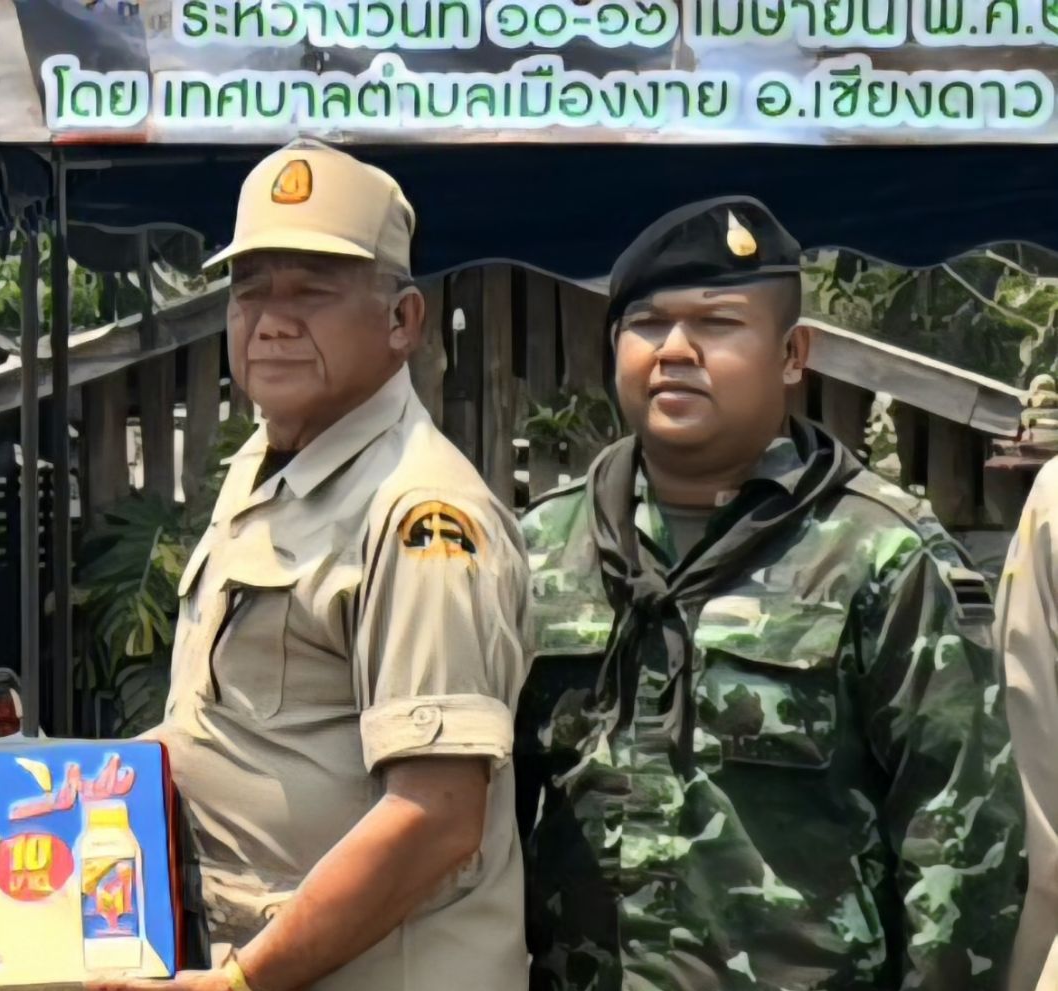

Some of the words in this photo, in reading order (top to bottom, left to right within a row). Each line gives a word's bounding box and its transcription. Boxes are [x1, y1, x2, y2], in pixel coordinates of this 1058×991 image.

[53, 65, 137, 118] โดย
[164, 62, 728, 118] เทศบาลตำบลเมืองงาย
[756, 64, 1043, 118] อ.เชียงดาว
